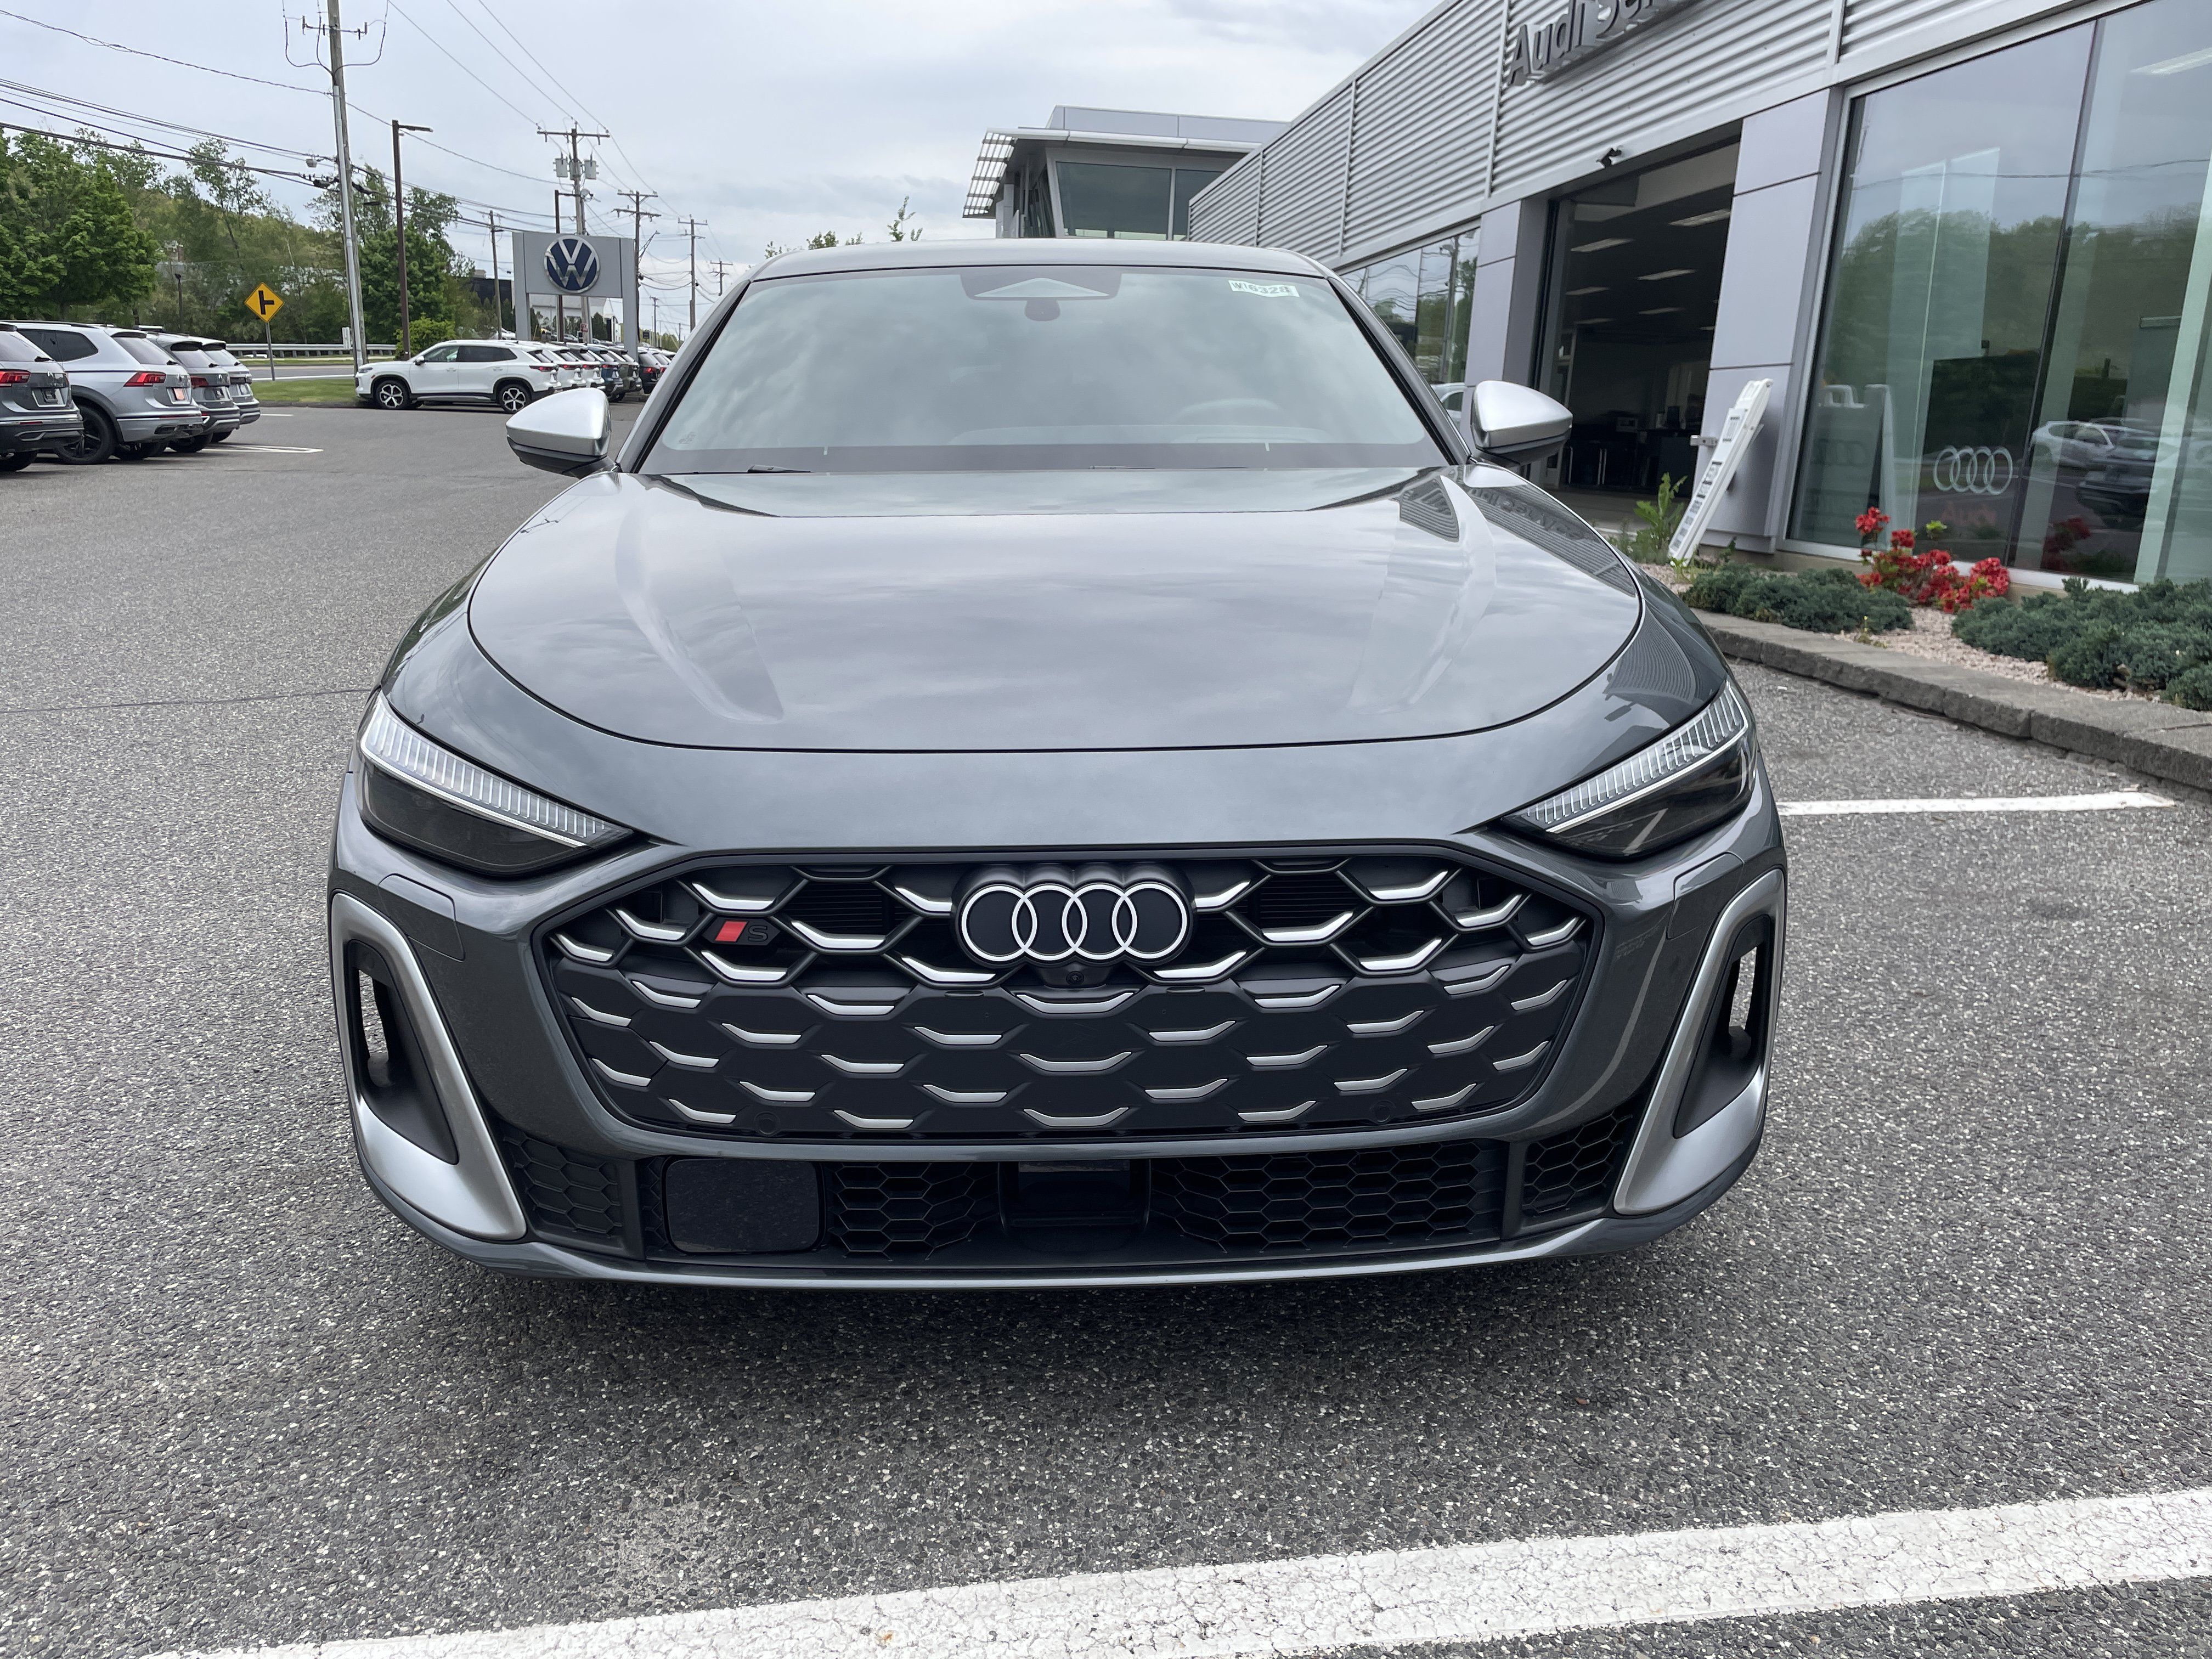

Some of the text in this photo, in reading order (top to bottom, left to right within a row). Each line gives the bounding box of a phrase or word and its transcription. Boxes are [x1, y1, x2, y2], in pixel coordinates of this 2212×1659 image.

[1509, 0, 1585, 86] Audi
[546, 238, 598, 288] VW
[748, 925, 768, 942] S
